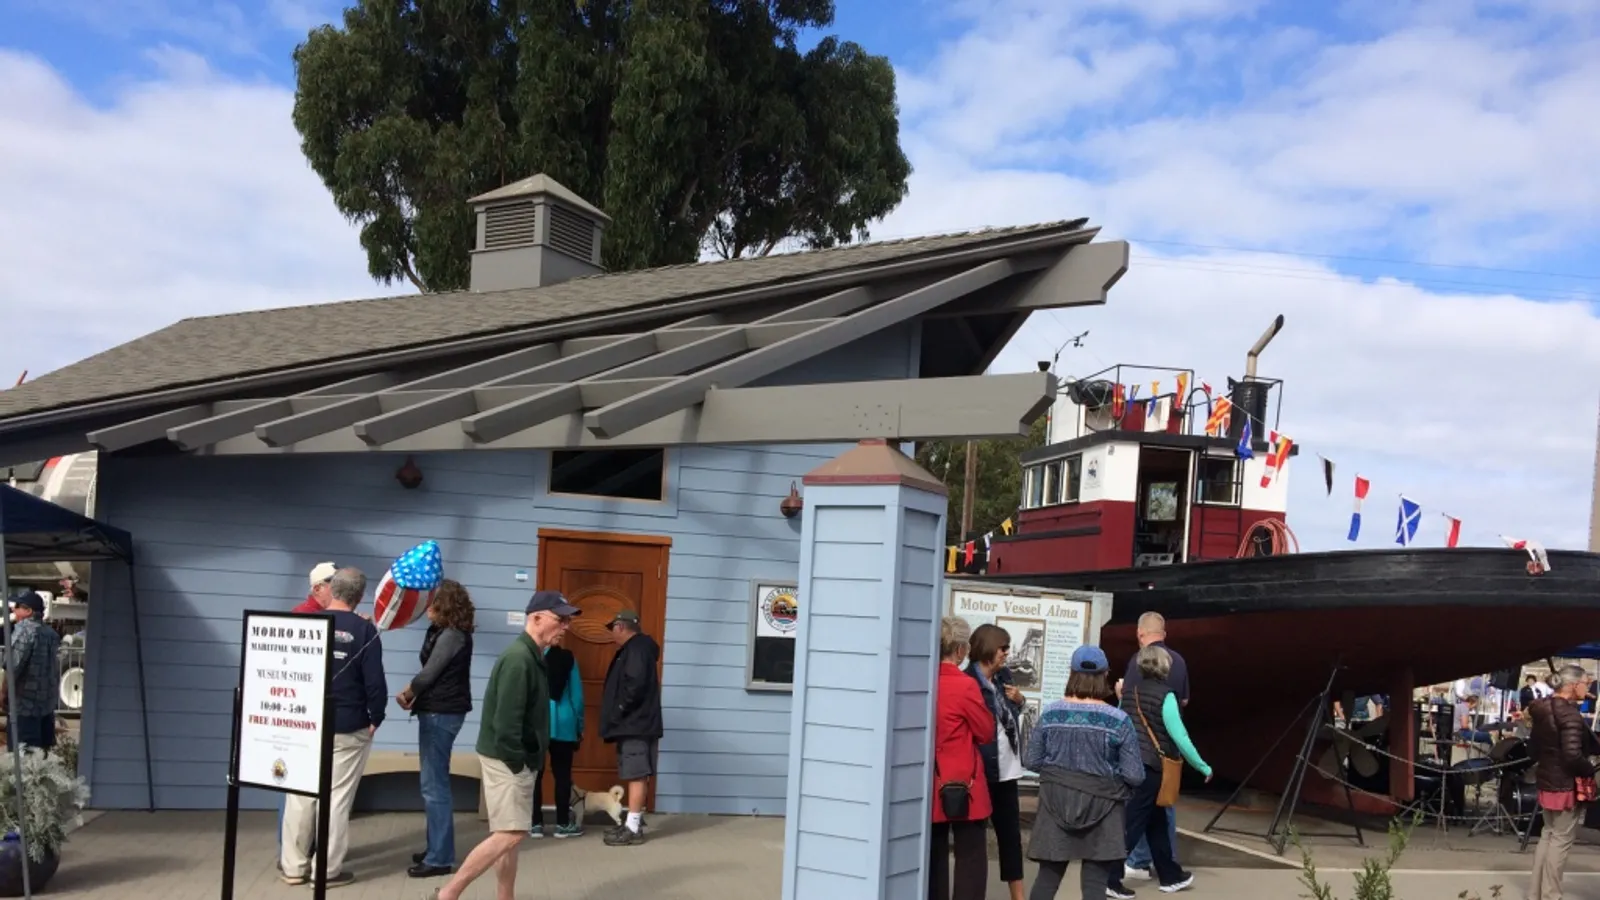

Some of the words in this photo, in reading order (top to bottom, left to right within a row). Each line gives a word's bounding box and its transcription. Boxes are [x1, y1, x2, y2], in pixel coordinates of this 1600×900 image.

[960, 597, 998, 612] Motor
[1004, 600, 1041, 616] Vessel
[1046, 605, 1078, 619] Alma
[252, 626, 294, 639] MORRO
[298, 628, 323, 641] BAY
[251, 643, 288, 653] MARITIME
[291, 645, 323, 655] MUSEUM
[257, 668, 287, 681] MUSEUM
[289, 671, 313, 683] STORE
[270, 686, 296, 698] OPEN
[260, 701, 281, 712] 10:00
[289, 703, 307, 714] 5:00
[248, 714, 269, 725] FREE
[271, 717, 317, 731] ADMISSION
